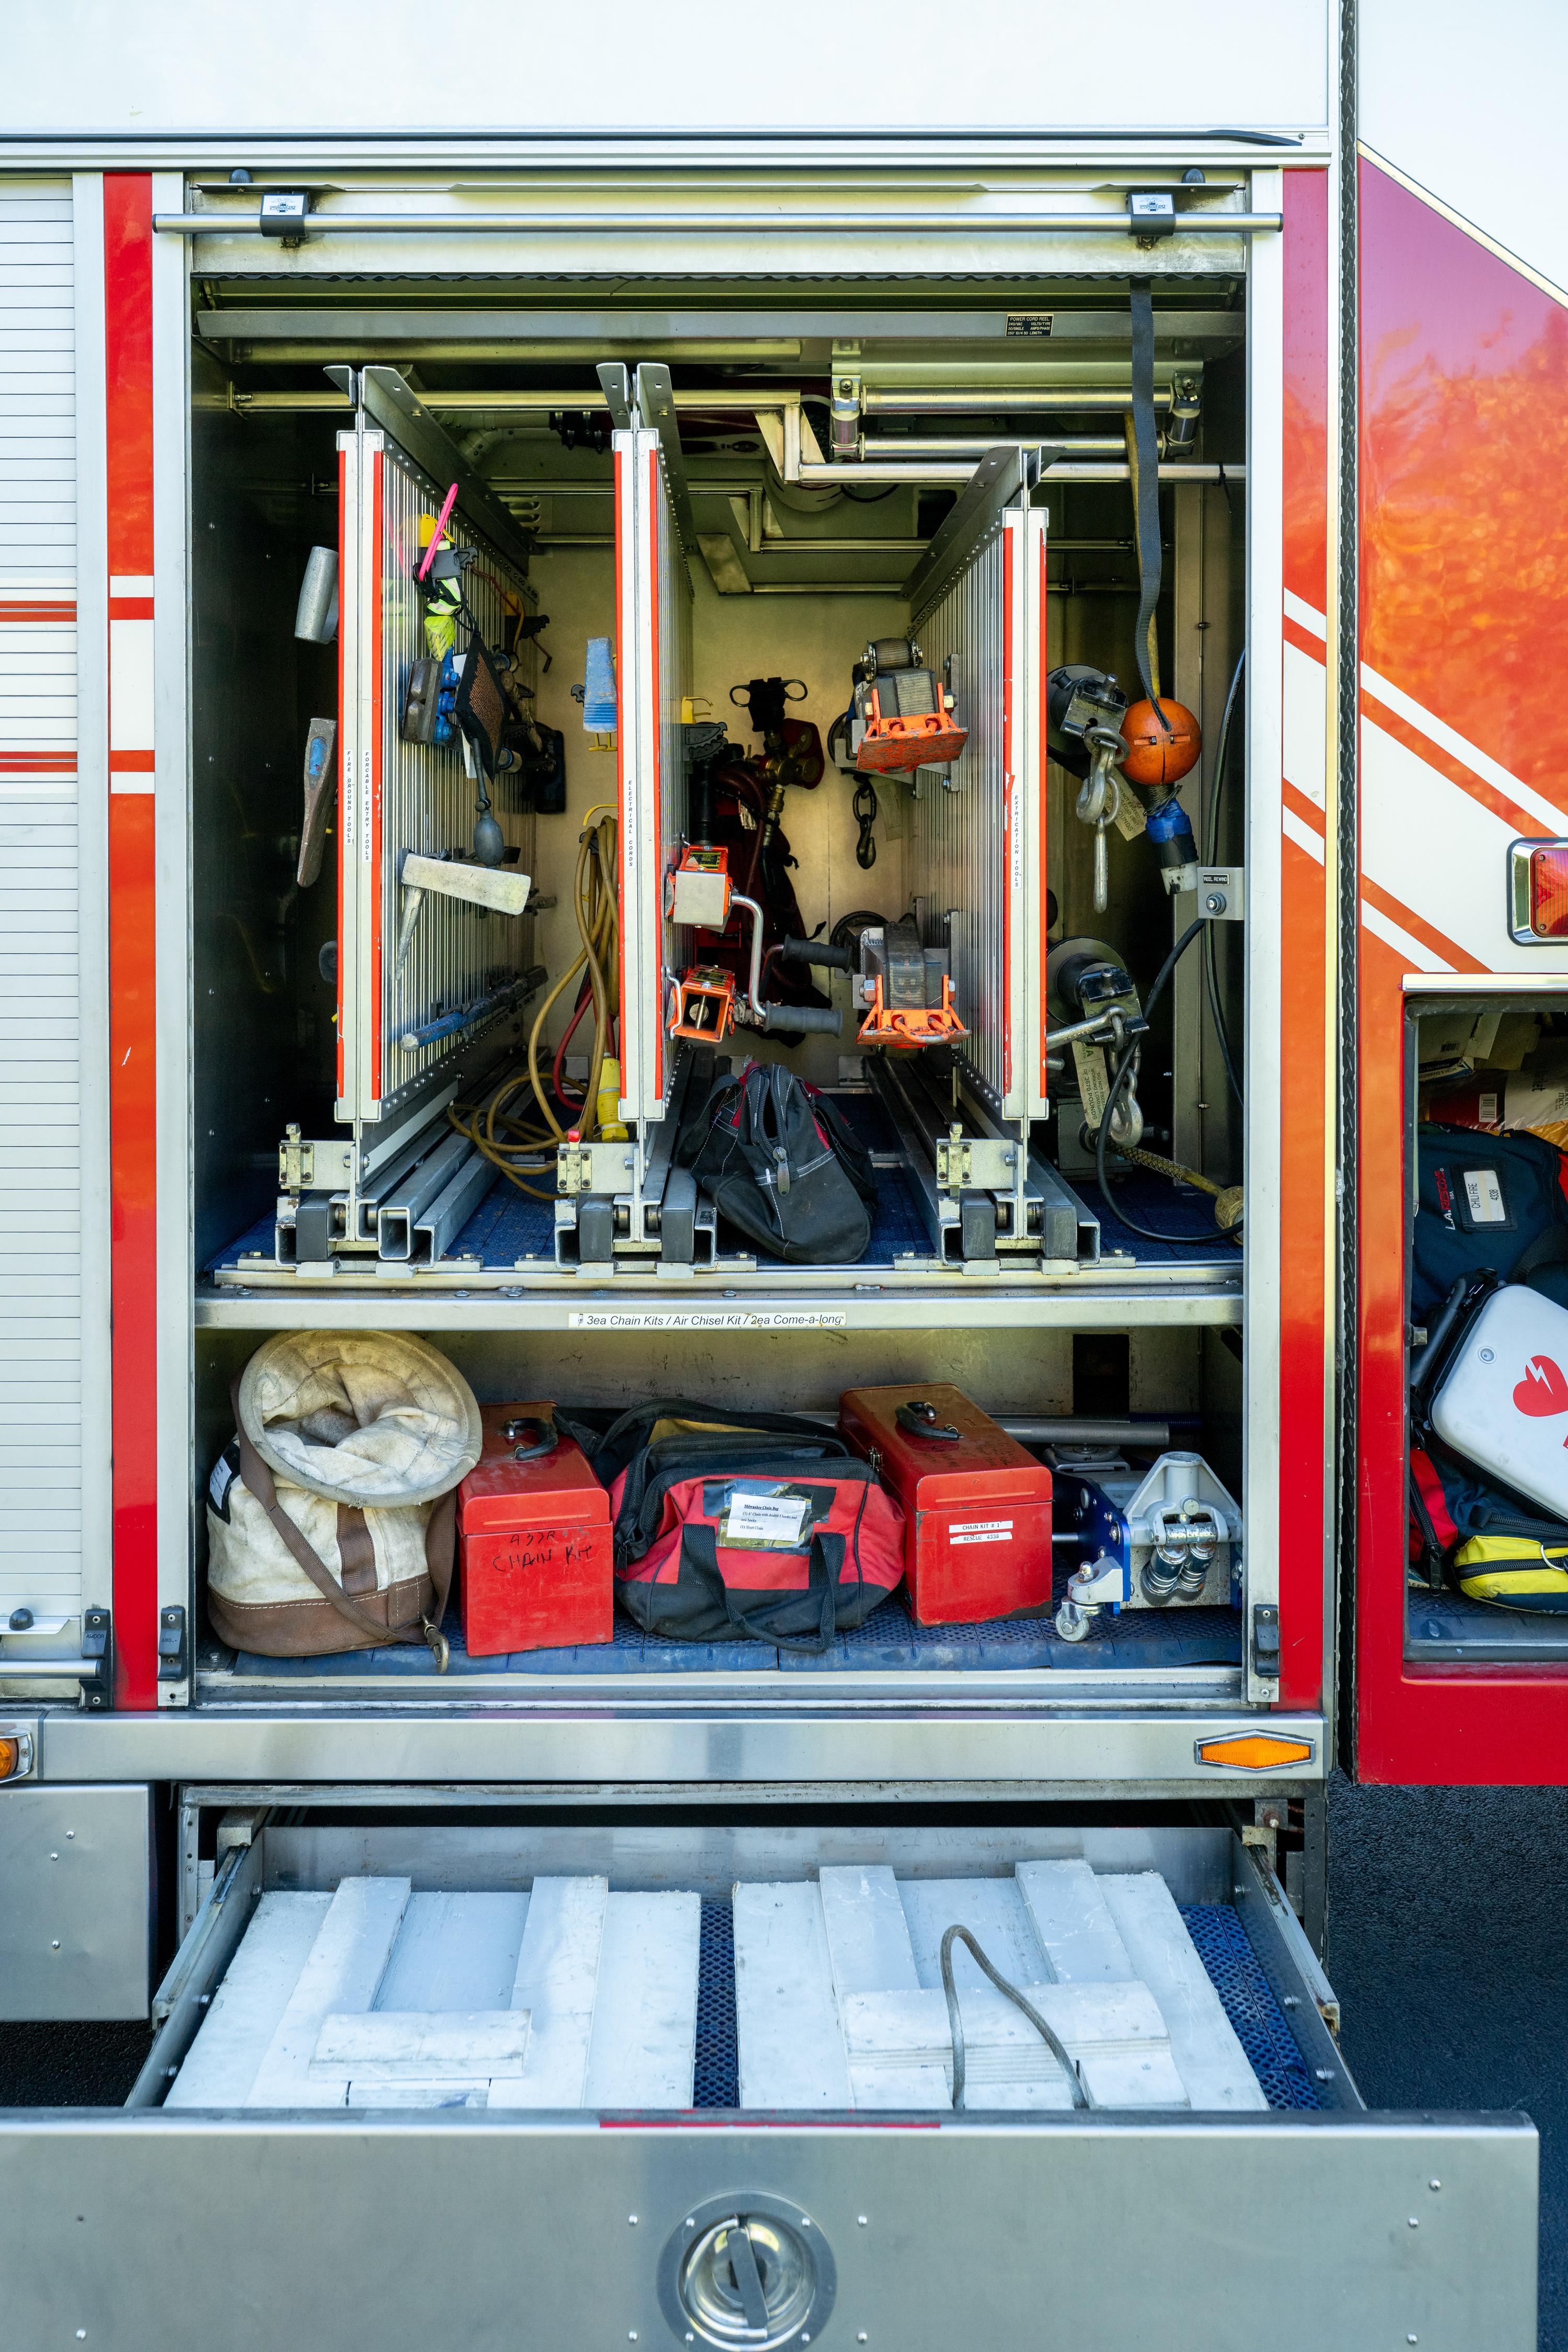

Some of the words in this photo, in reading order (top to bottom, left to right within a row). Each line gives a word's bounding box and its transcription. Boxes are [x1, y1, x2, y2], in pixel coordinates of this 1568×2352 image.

[1118, 811, 1133, 832] OUNDS
[1088, 1092, 1098, 1120] POUNDS
[1468, 1183, 1479, 1194] FIRE
[1489, 1189, 1499, 1201] 4338
[1470, 1195, 1481, 1208] CHILI
[586, 1316, 606, 1325] 3ea
[610, 1315, 641, 1325] Chain
[644, 1315, 663, 1325] Kits
[666, 1315, 671, 1325] /
[673, 1315, 688, 1325] Air
[691, 1315, 724, 1325] Chisel
[727, 1315, 742, 1324] Kit
[751, 1316, 770, 1325] 2ea
[774, 1314, 843, 1327] Come-a-long
[493, 1549, 552, 1572] CHAIN
